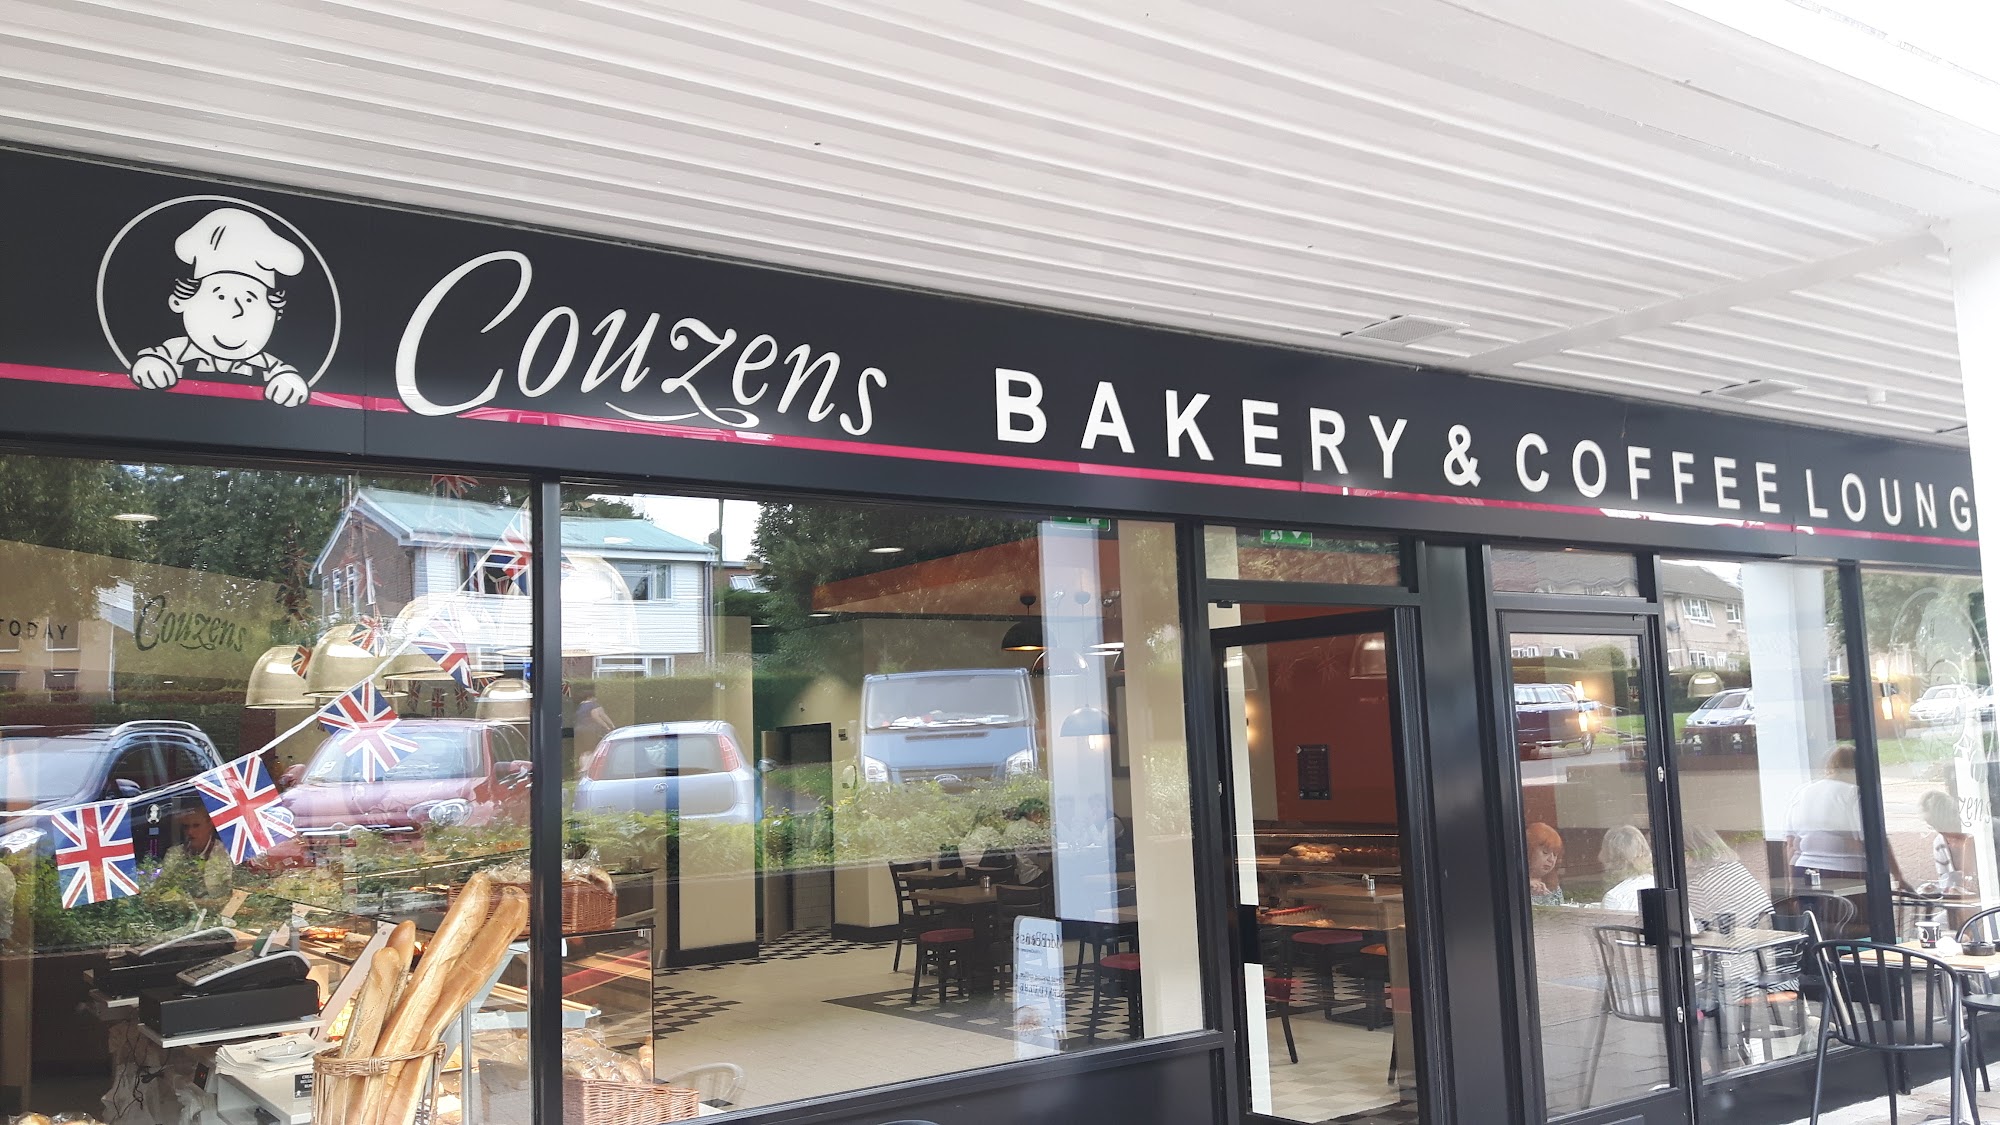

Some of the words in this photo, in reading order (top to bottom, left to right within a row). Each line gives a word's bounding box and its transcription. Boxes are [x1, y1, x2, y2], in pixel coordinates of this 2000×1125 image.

[394, 250, 888, 437] Couzens
[994, 367, 1408, 480] BAKERY
[1443, 424, 1482, 488] &
[1515, 431, 1782, 519] COFFEE
[1804, 467, 1973, 533] LOUNG
[135, 594, 249, 653] Couzens
